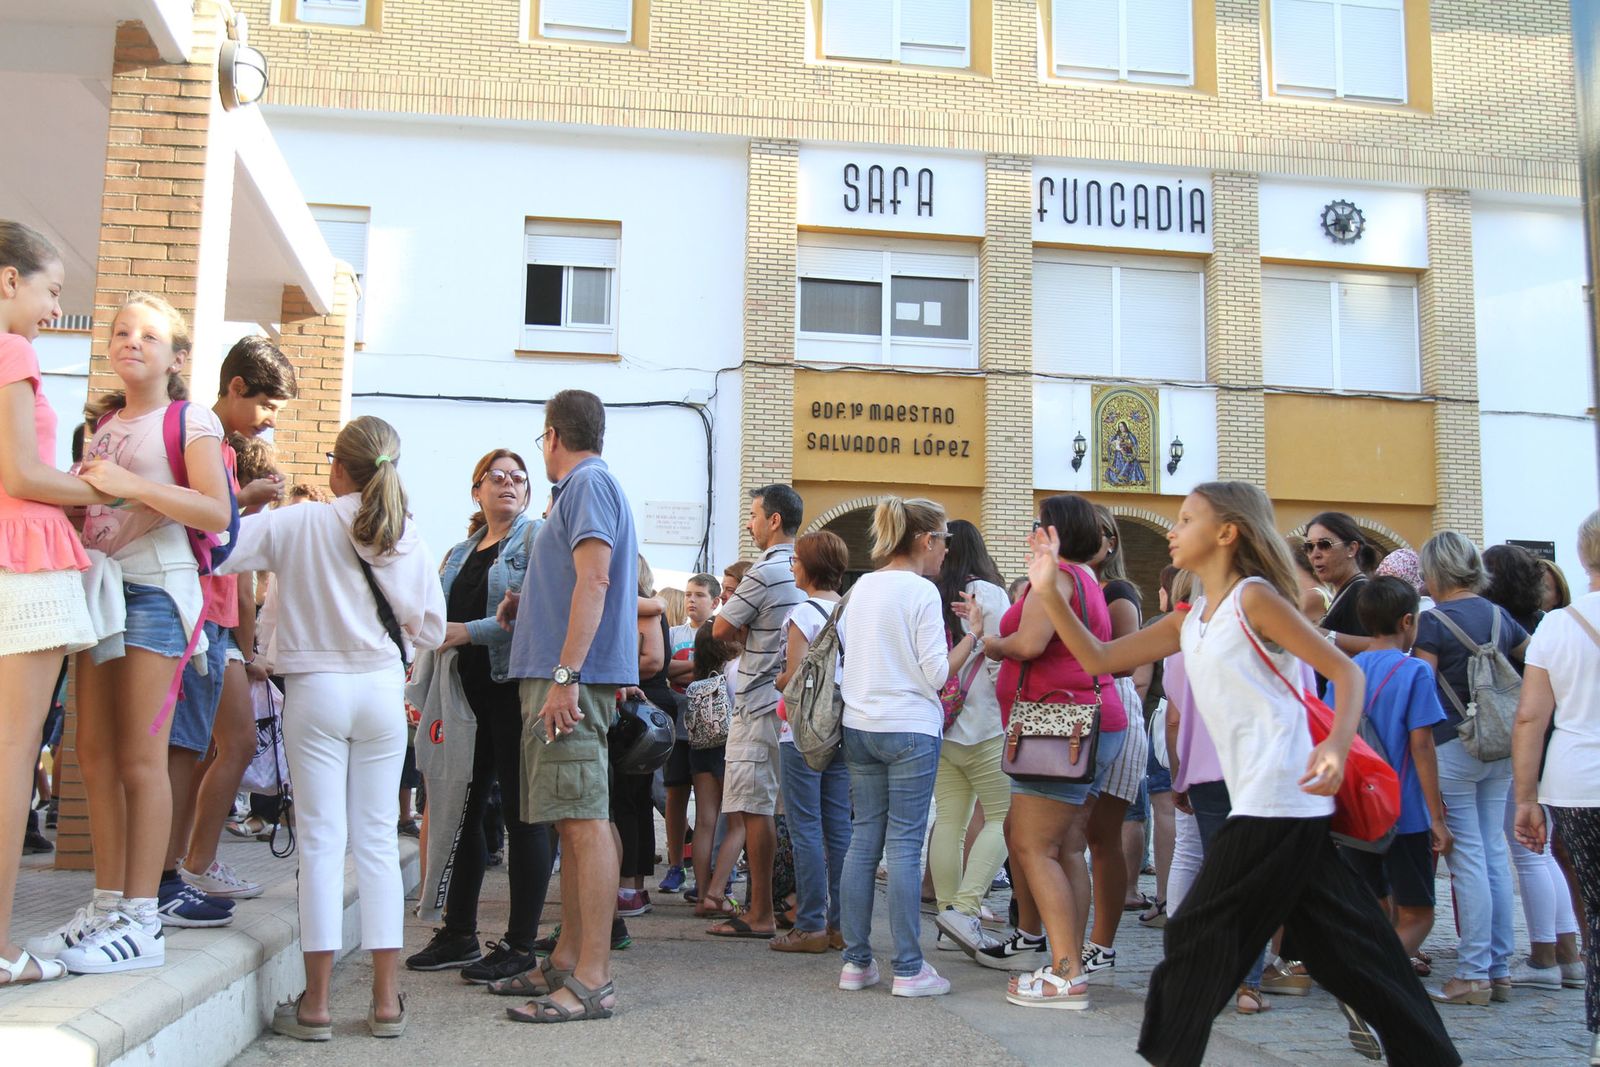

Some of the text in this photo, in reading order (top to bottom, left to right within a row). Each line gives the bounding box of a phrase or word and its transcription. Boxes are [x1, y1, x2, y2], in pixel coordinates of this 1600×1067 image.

[843, 163, 934, 217] SAFA
[869, 403, 955, 425] MAESTRO
[807, 432, 970, 458] SALVADOR LÓPEZ
